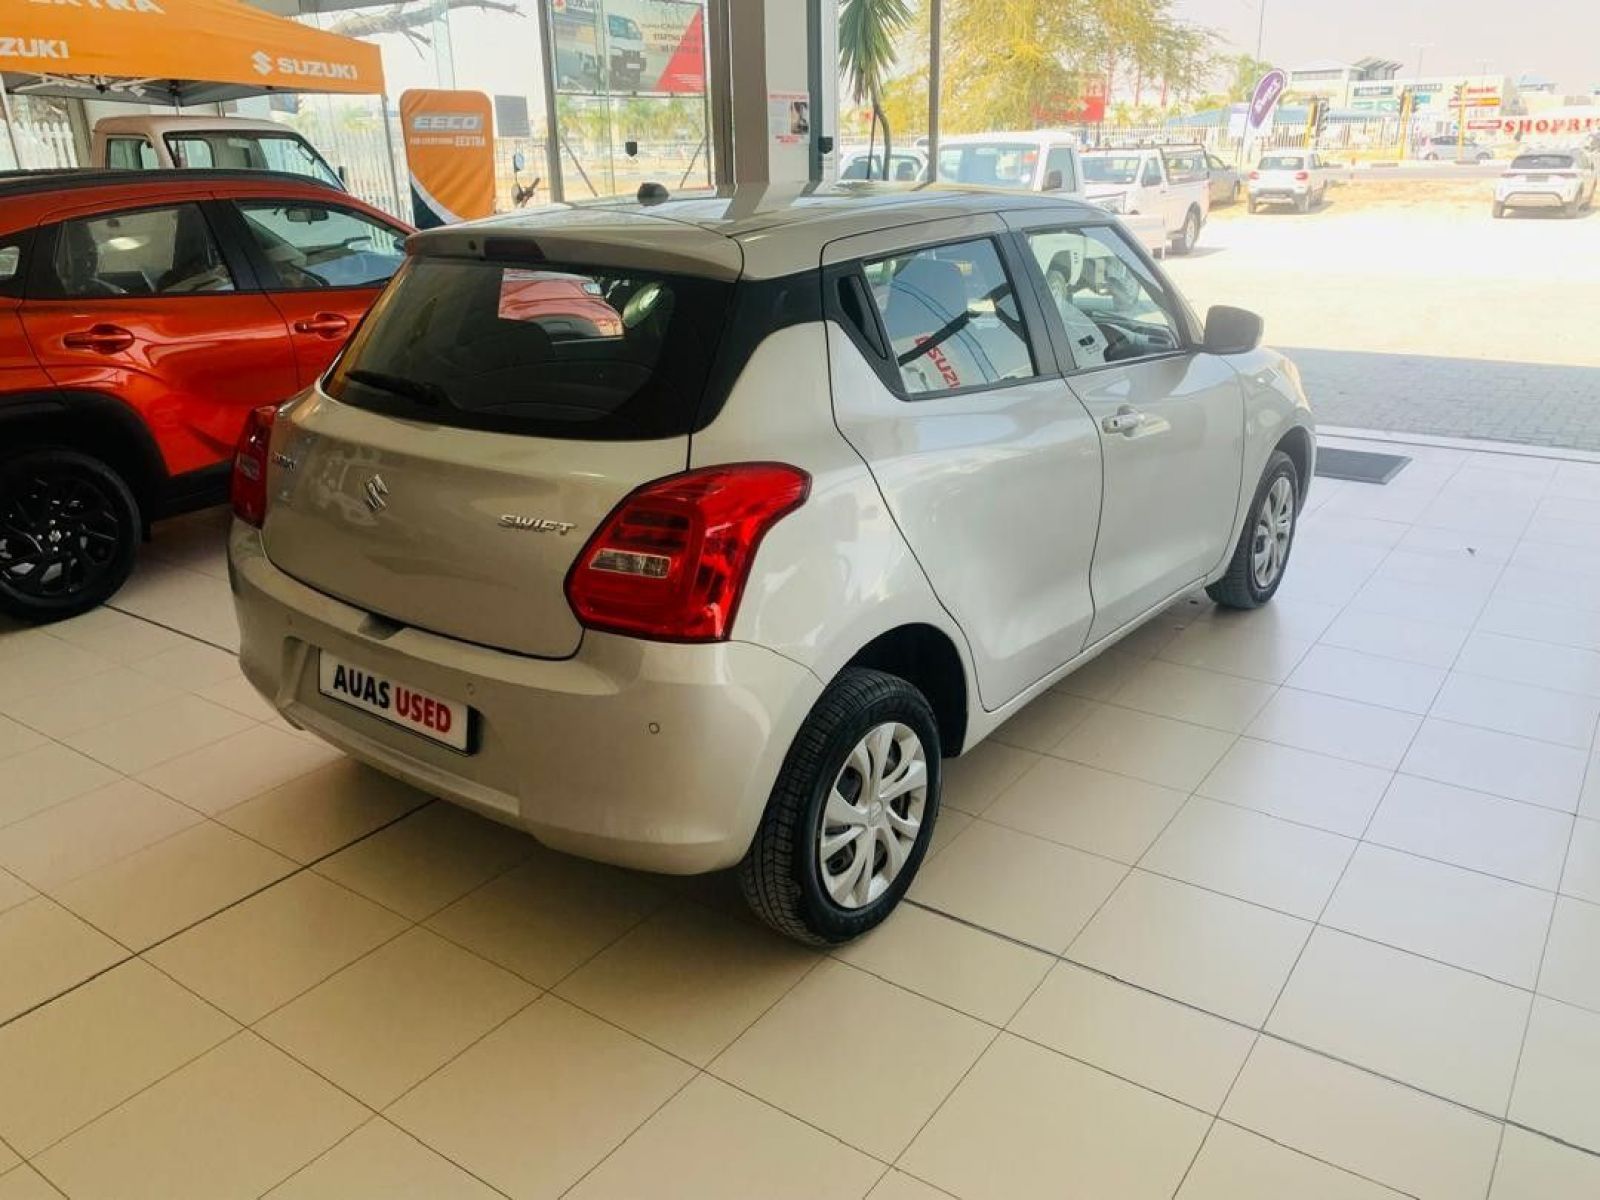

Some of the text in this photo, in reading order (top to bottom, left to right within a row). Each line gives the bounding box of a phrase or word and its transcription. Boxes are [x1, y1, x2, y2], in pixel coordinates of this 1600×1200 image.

[276, 57, 358, 80] SUZUKI
[498, 513, 576, 535] SWIFT
[333, 664, 452, 732] AUAS USED
